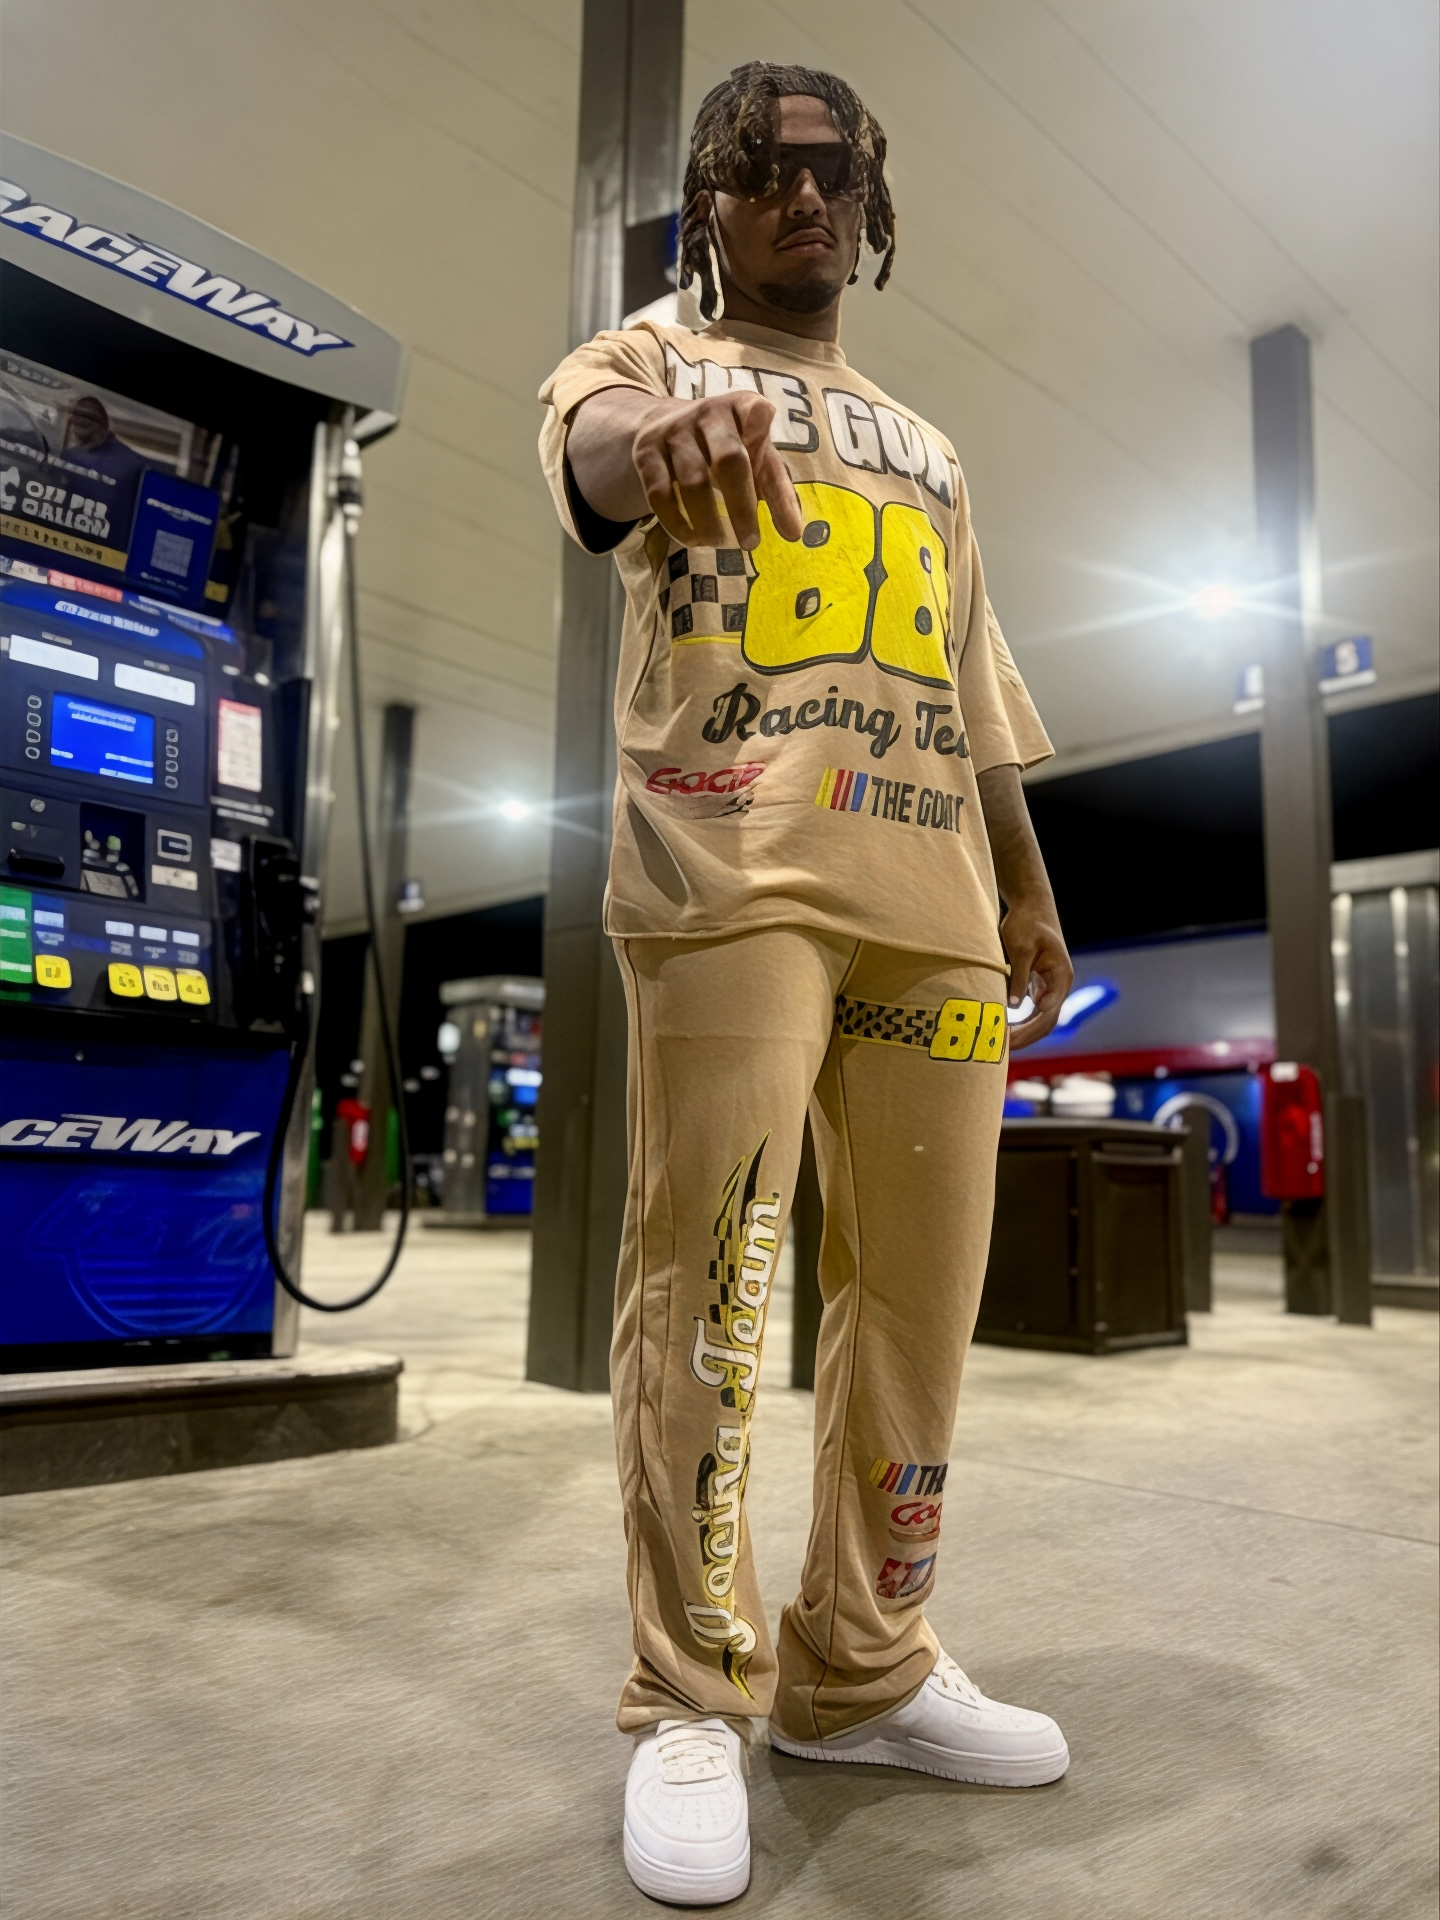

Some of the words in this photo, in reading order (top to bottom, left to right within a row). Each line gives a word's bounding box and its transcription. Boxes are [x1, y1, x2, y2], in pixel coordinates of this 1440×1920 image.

[741, 481, 957, 692] 88
[702, 682, 901, 759] Racing
[871, 775, 916, 824] THE
[0, 1113, 262, 1155] CEWAY
